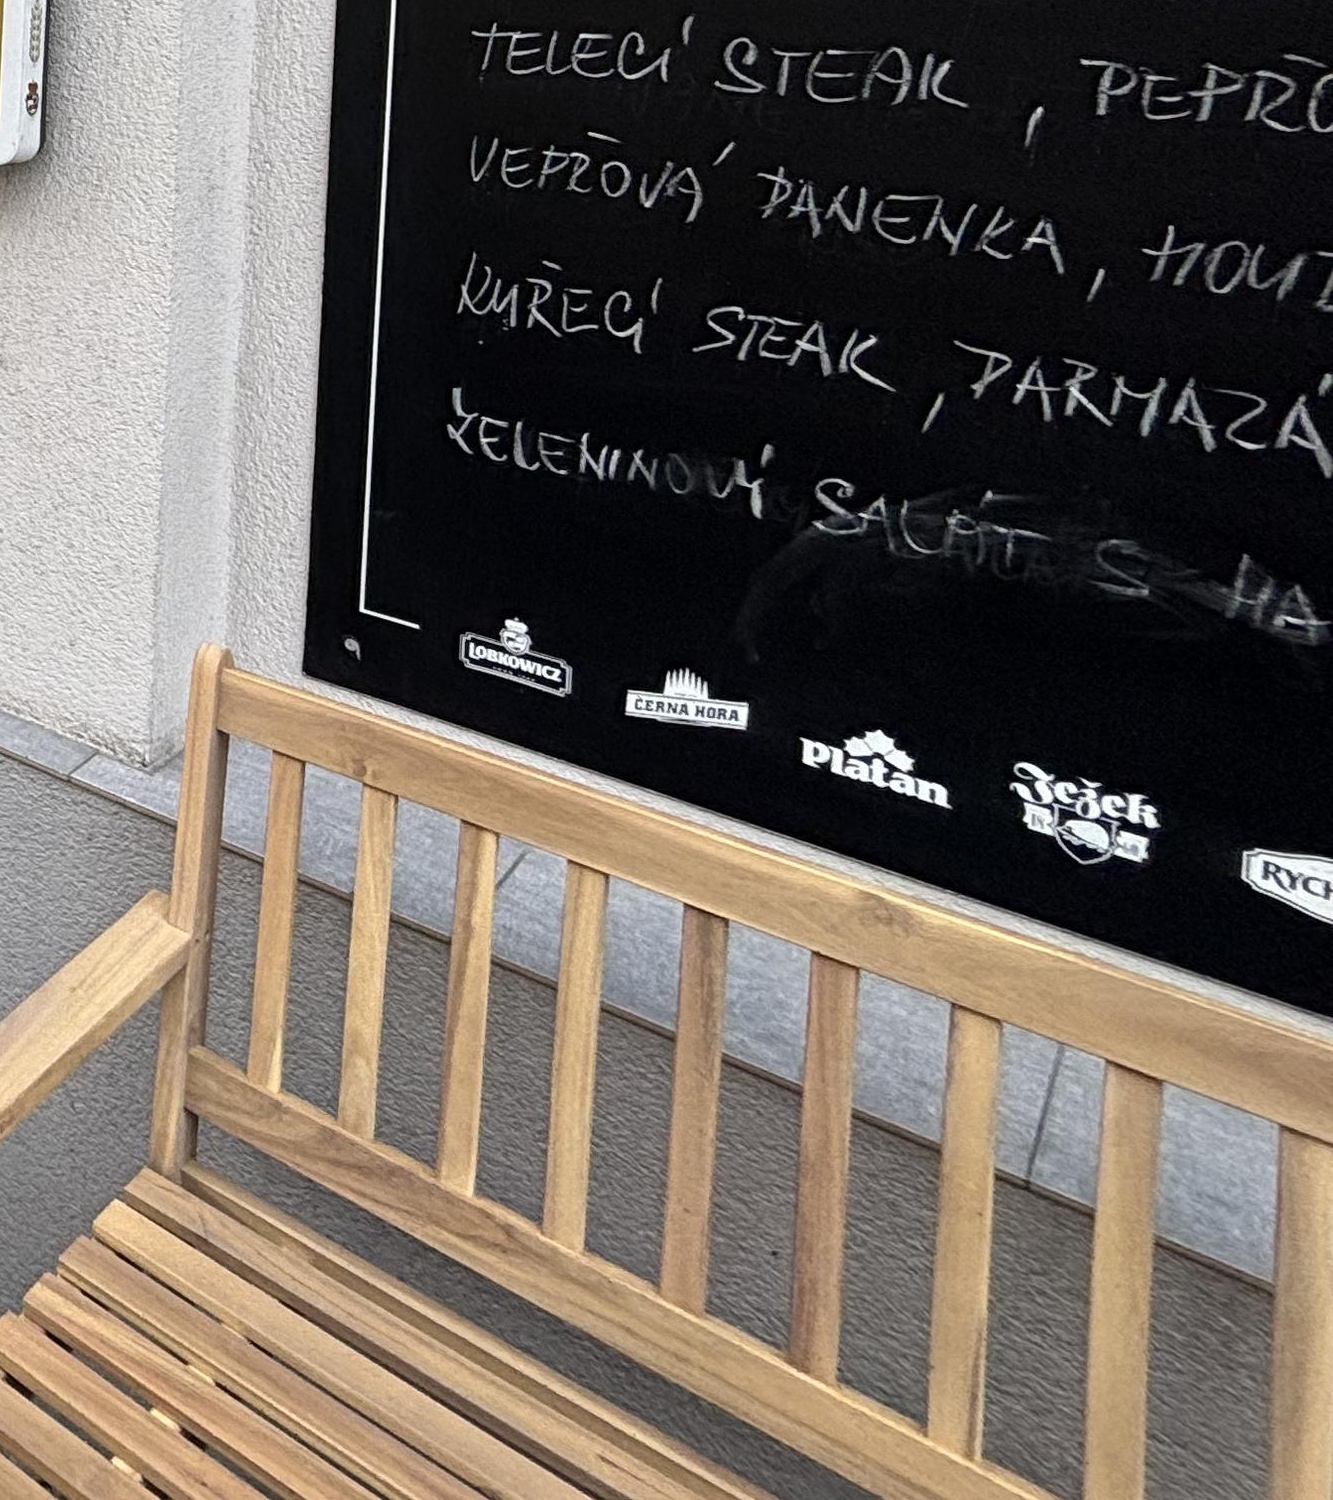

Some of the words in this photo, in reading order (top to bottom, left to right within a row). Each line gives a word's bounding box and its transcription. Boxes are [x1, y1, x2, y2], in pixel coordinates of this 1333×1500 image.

[468, 641, 563, 683] LOBKOWICZ
[694, 705, 740, 722] HORA
[799, 736, 954, 810] Platan
